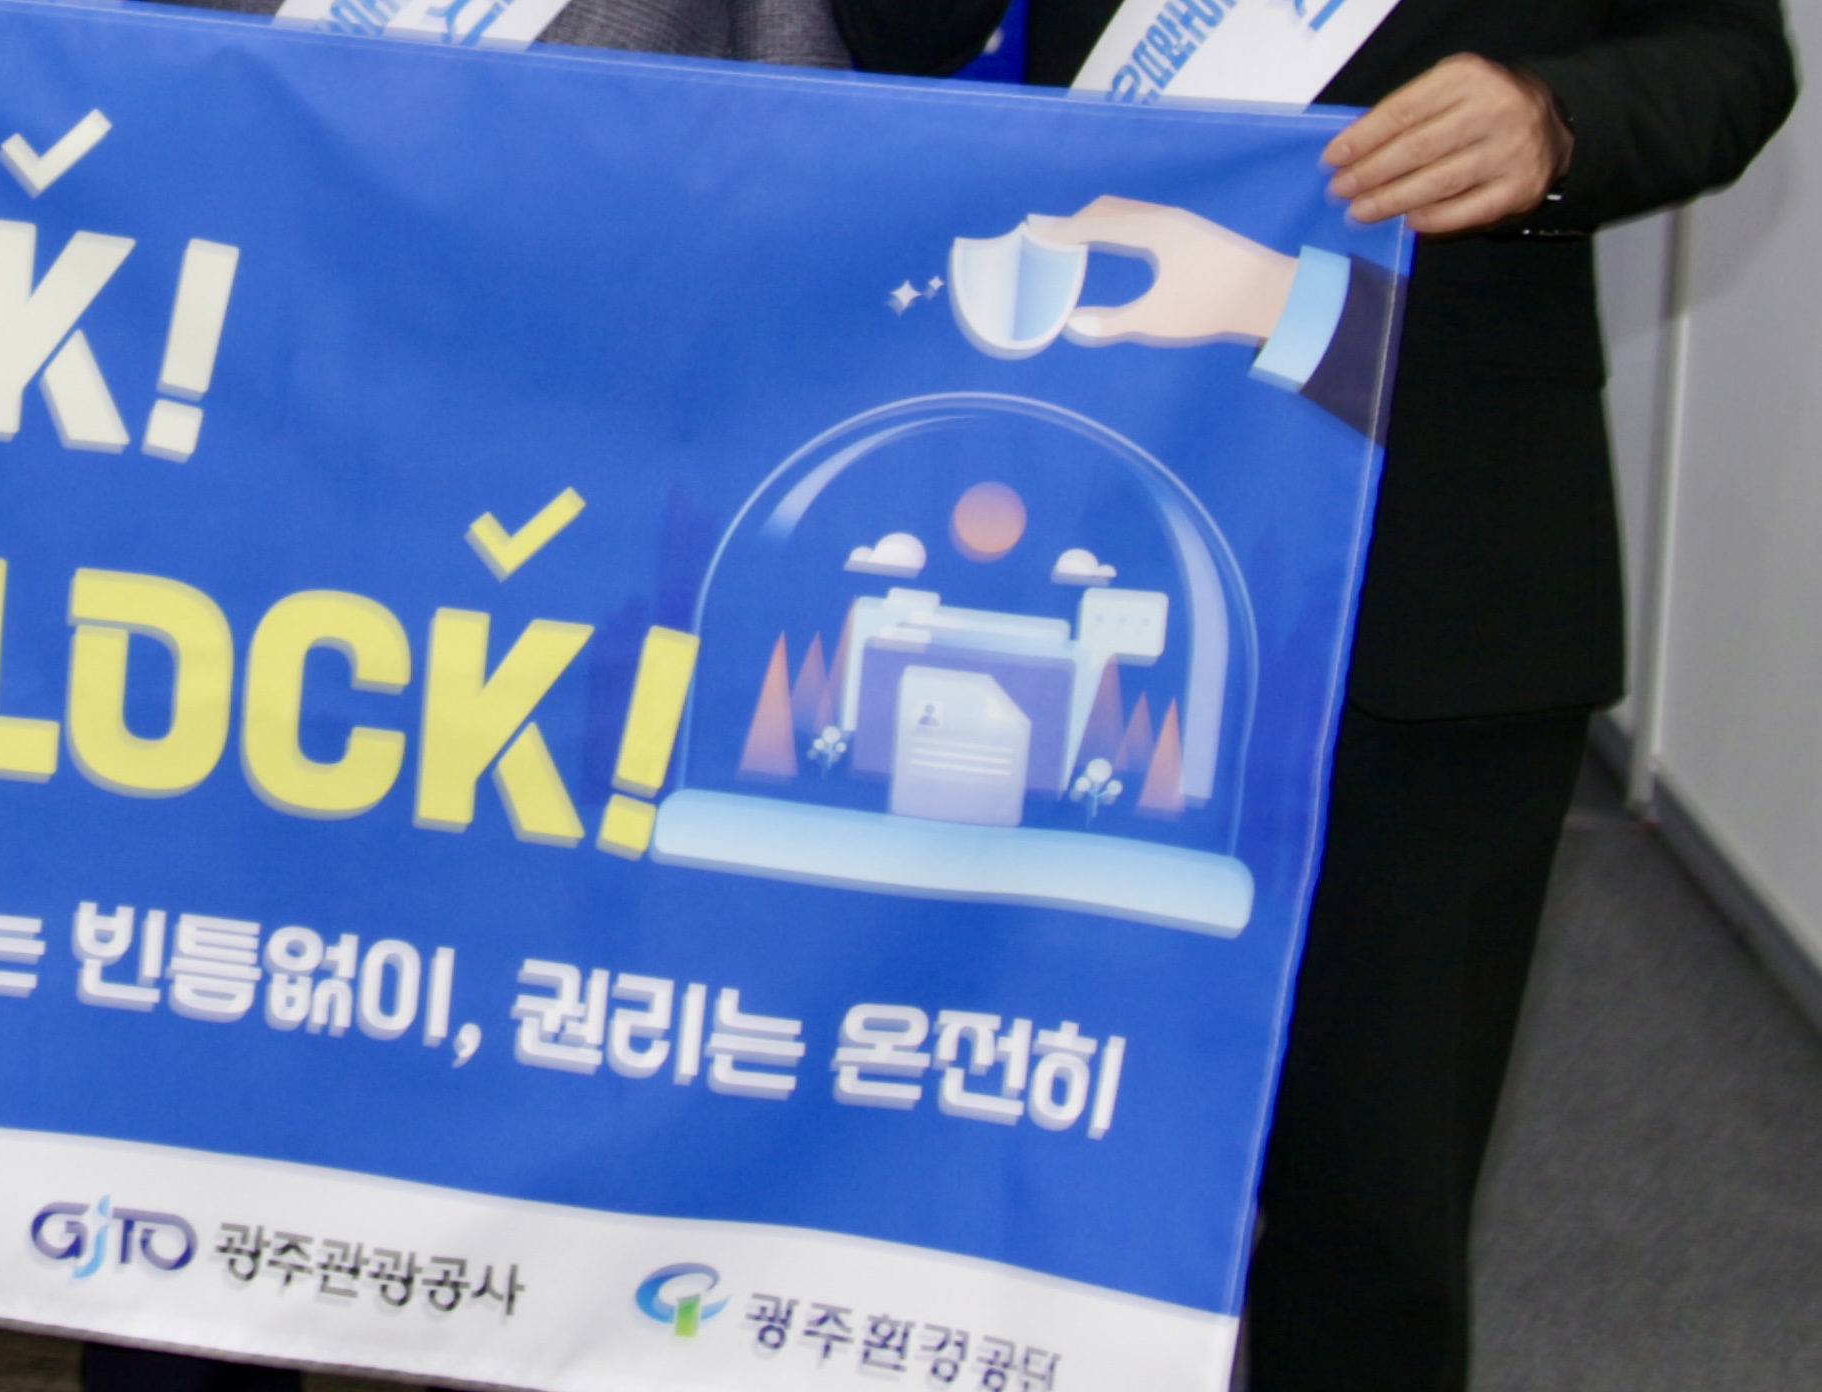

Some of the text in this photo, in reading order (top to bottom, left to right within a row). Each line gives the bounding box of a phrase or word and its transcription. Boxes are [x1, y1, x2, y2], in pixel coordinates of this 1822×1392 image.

[72, 900, 482, 1068] 빈틈없이,
[511, 957, 807, 1101] 권리는
[831, 1001, 1127, 1141] 온전히
[215, 1220, 526, 1316] 광주관광공사
